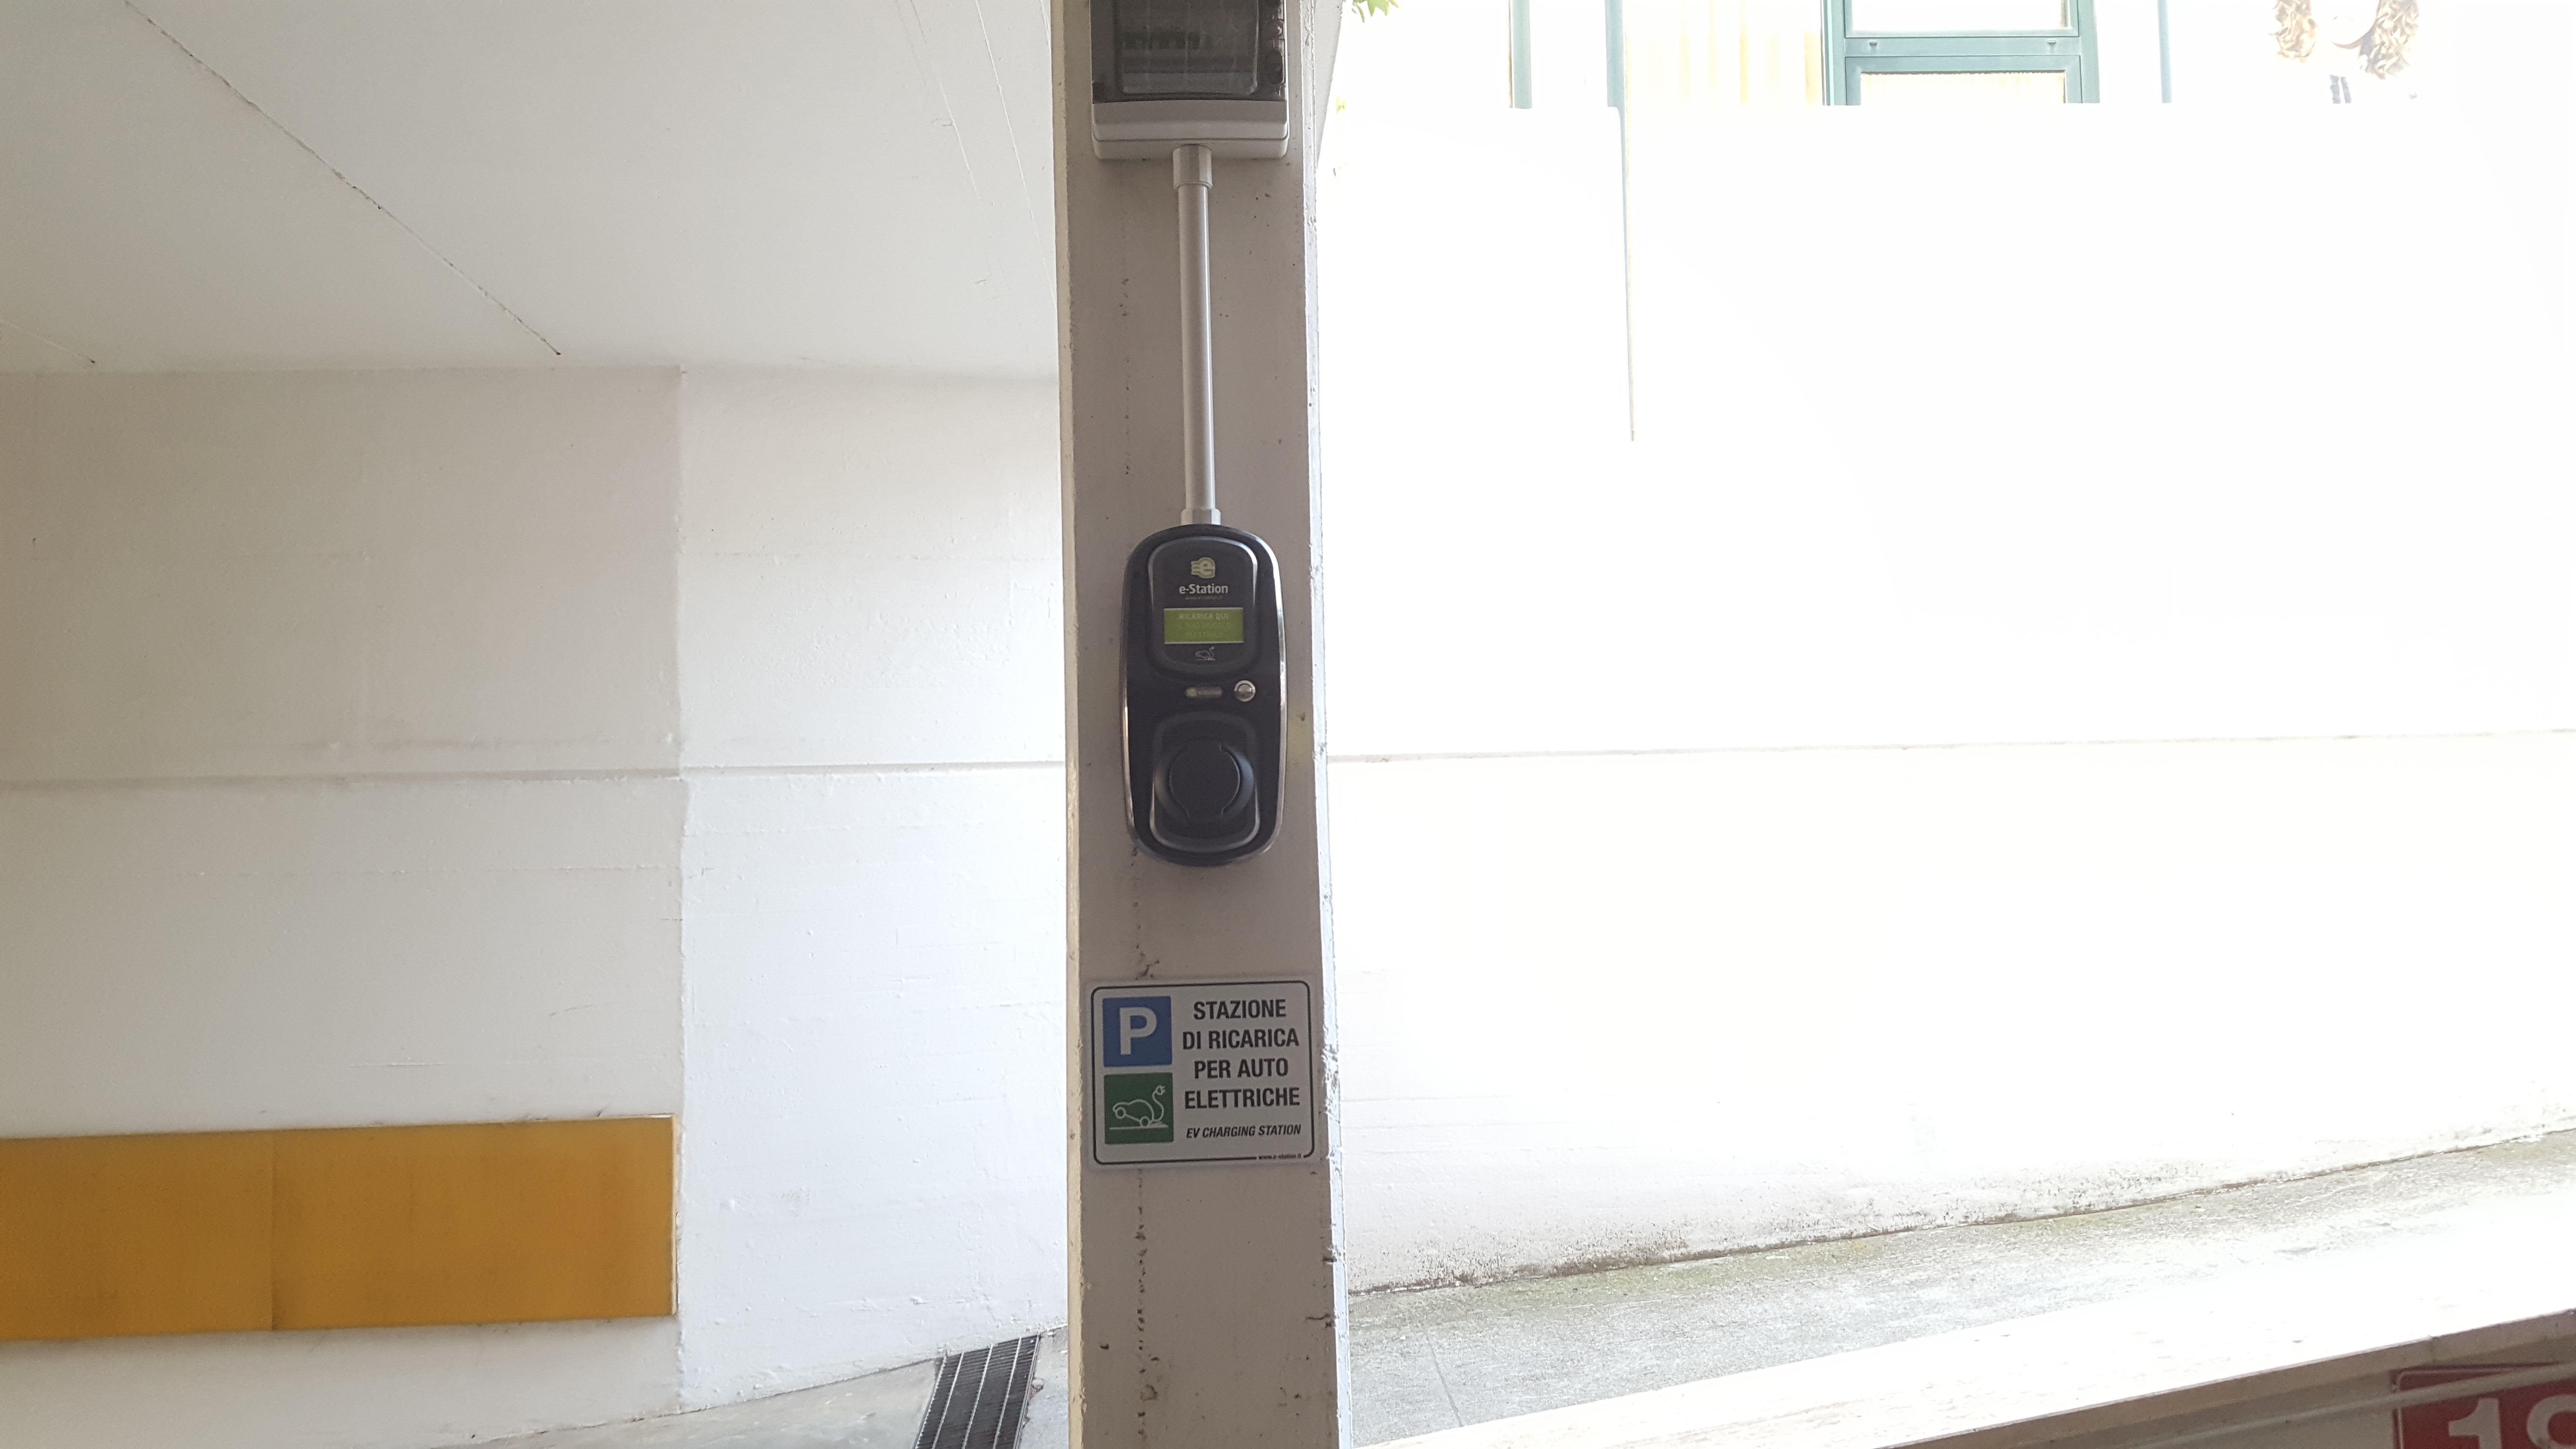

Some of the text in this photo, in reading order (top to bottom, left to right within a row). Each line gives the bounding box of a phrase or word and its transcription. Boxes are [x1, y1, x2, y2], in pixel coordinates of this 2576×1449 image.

[1179, 583, 1228, 595] e-Station
[1215, 612, 1229, 620] QUI
[1193, 999, 1286, 1019] STAZIONE
[1119, 1007, 1157, 1055] P
[1182, 1028, 1300, 1050] DI RICARICA
[1194, 1058, 1288, 1079] PER AUTO
[1185, 1087, 1301, 1110] ELETTRICHE
[1186, 1124, 1301, 1138] EV CHARGING STATION
